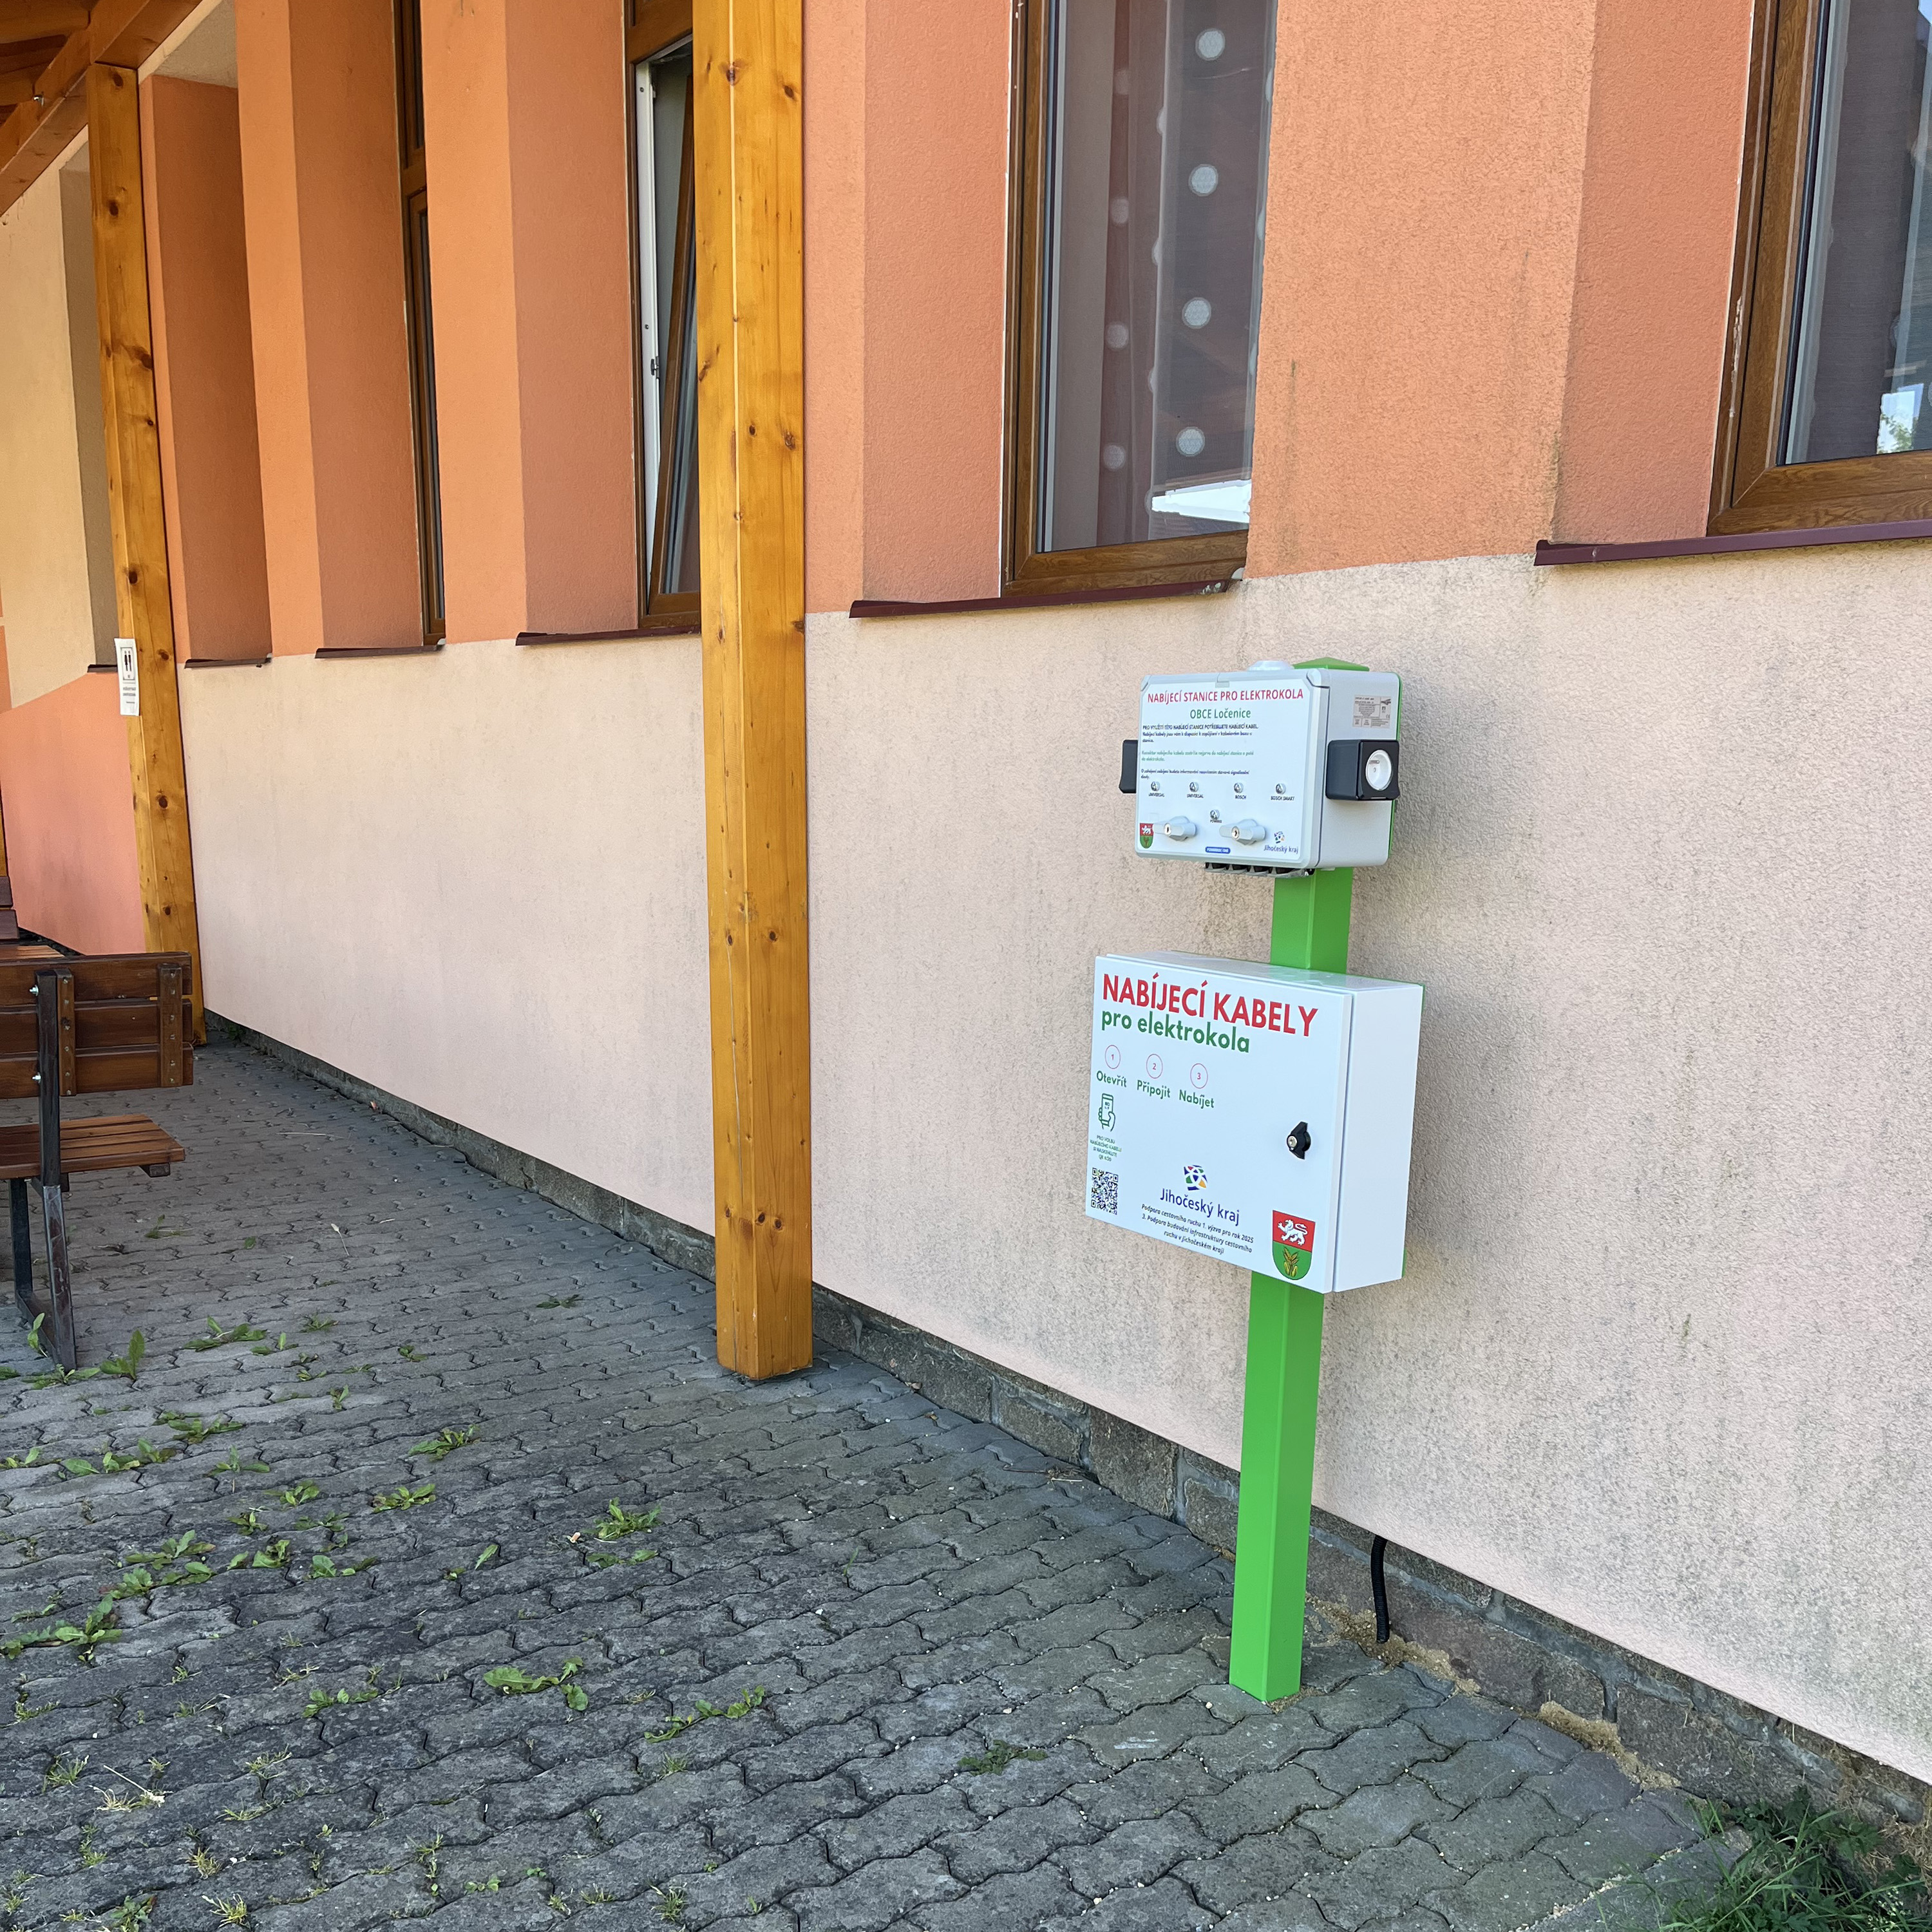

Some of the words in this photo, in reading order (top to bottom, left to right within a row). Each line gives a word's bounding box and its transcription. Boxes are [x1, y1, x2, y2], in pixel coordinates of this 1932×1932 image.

[1148, 690, 1182, 705] NABÍJECÍ
[1184, 692, 1218, 702] STANICE
[1220, 691, 1238, 701] PRO
[1240, 688, 1303, 700] ELEKTROKOLA
[1190, 709, 1212, 719] OBCE
[1214, 707, 1251, 718] Ločenice
[1264, 844, 1287, 854] Jihočeský
[1103, 972, 1208, 1018] NABÍJECÍ
[1213, 992, 1318, 1037] KABELY
[1102, 1010, 1132, 1031] pro
[1137, 1010, 1250, 1053] elektrokola
[1096, 1070, 1127, 1088] Otevřít
[1137, 1079, 1171, 1099] Připojit
[1179, 1089, 1215, 1109] Nabíjet
[1160, 1188, 1213, 1218] Jihočeský
[1217, 1204, 1239, 1227] kraj
[1141, 1204, 1160, 1215] Podpora
[1161, 1211, 1186, 1222] cestovního
[1208, 1224, 1222, 1233] výzva
[1241, 1234, 1254, 1244] 2025
[1147, 1215, 1166, 1226] Podpora
